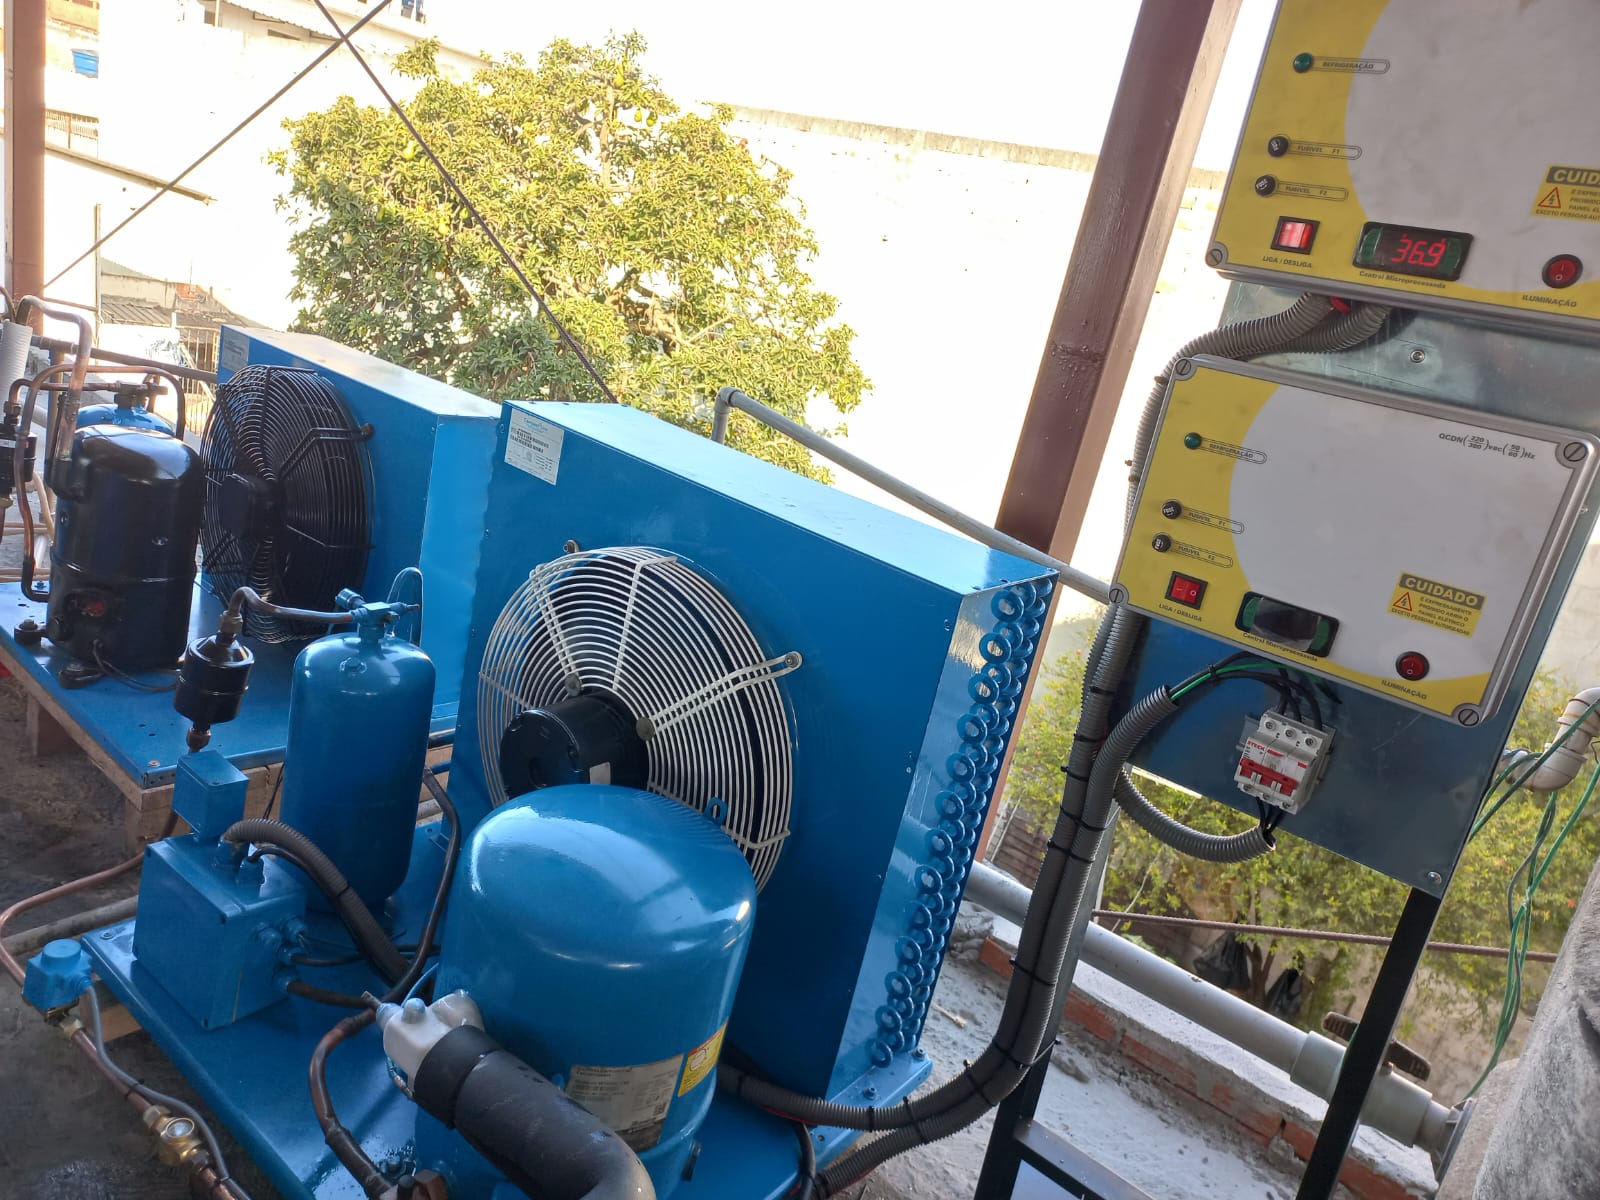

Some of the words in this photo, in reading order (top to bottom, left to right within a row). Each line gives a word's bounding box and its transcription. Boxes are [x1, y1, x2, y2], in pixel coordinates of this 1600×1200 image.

[1553, 169, 1600, 185] CUID
[1263, 255, 1278, 263] LIGA
[1283, 258, 1312, 268] DESLIGA
[1522, 294, 1577, 308] ILUMINAÇÃO
[1405, 577, 1478, 606] CUIDADO
[1247, 741, 1266, 752] STECK
